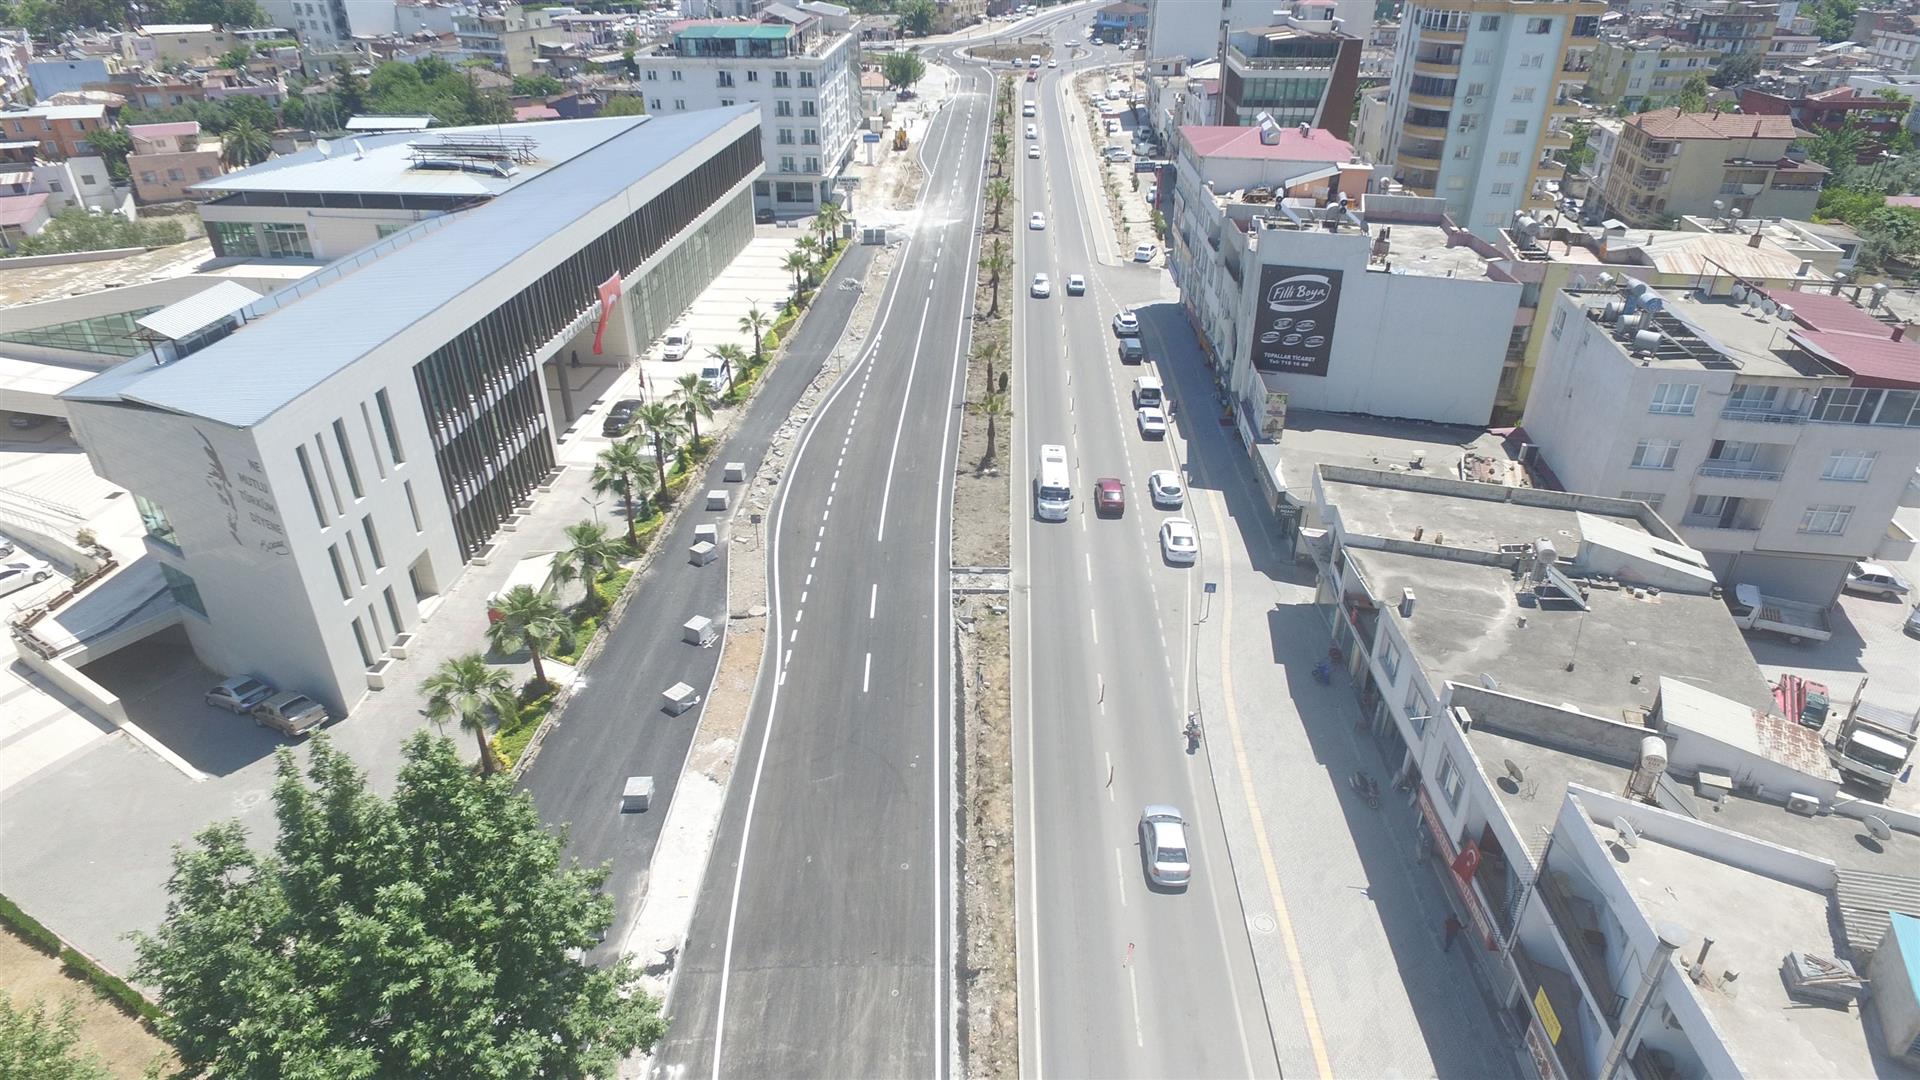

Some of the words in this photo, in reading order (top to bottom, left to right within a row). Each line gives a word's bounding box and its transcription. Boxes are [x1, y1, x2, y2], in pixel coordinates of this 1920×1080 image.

[1273, 286, 1294, 300] Filli
[1296, 285, 1326, 301] Boya
[1292, 354, 1316, 362] TİCARET
[248, 459, 262, 472] NE
[238, 472, 269, 494] MUTLU
